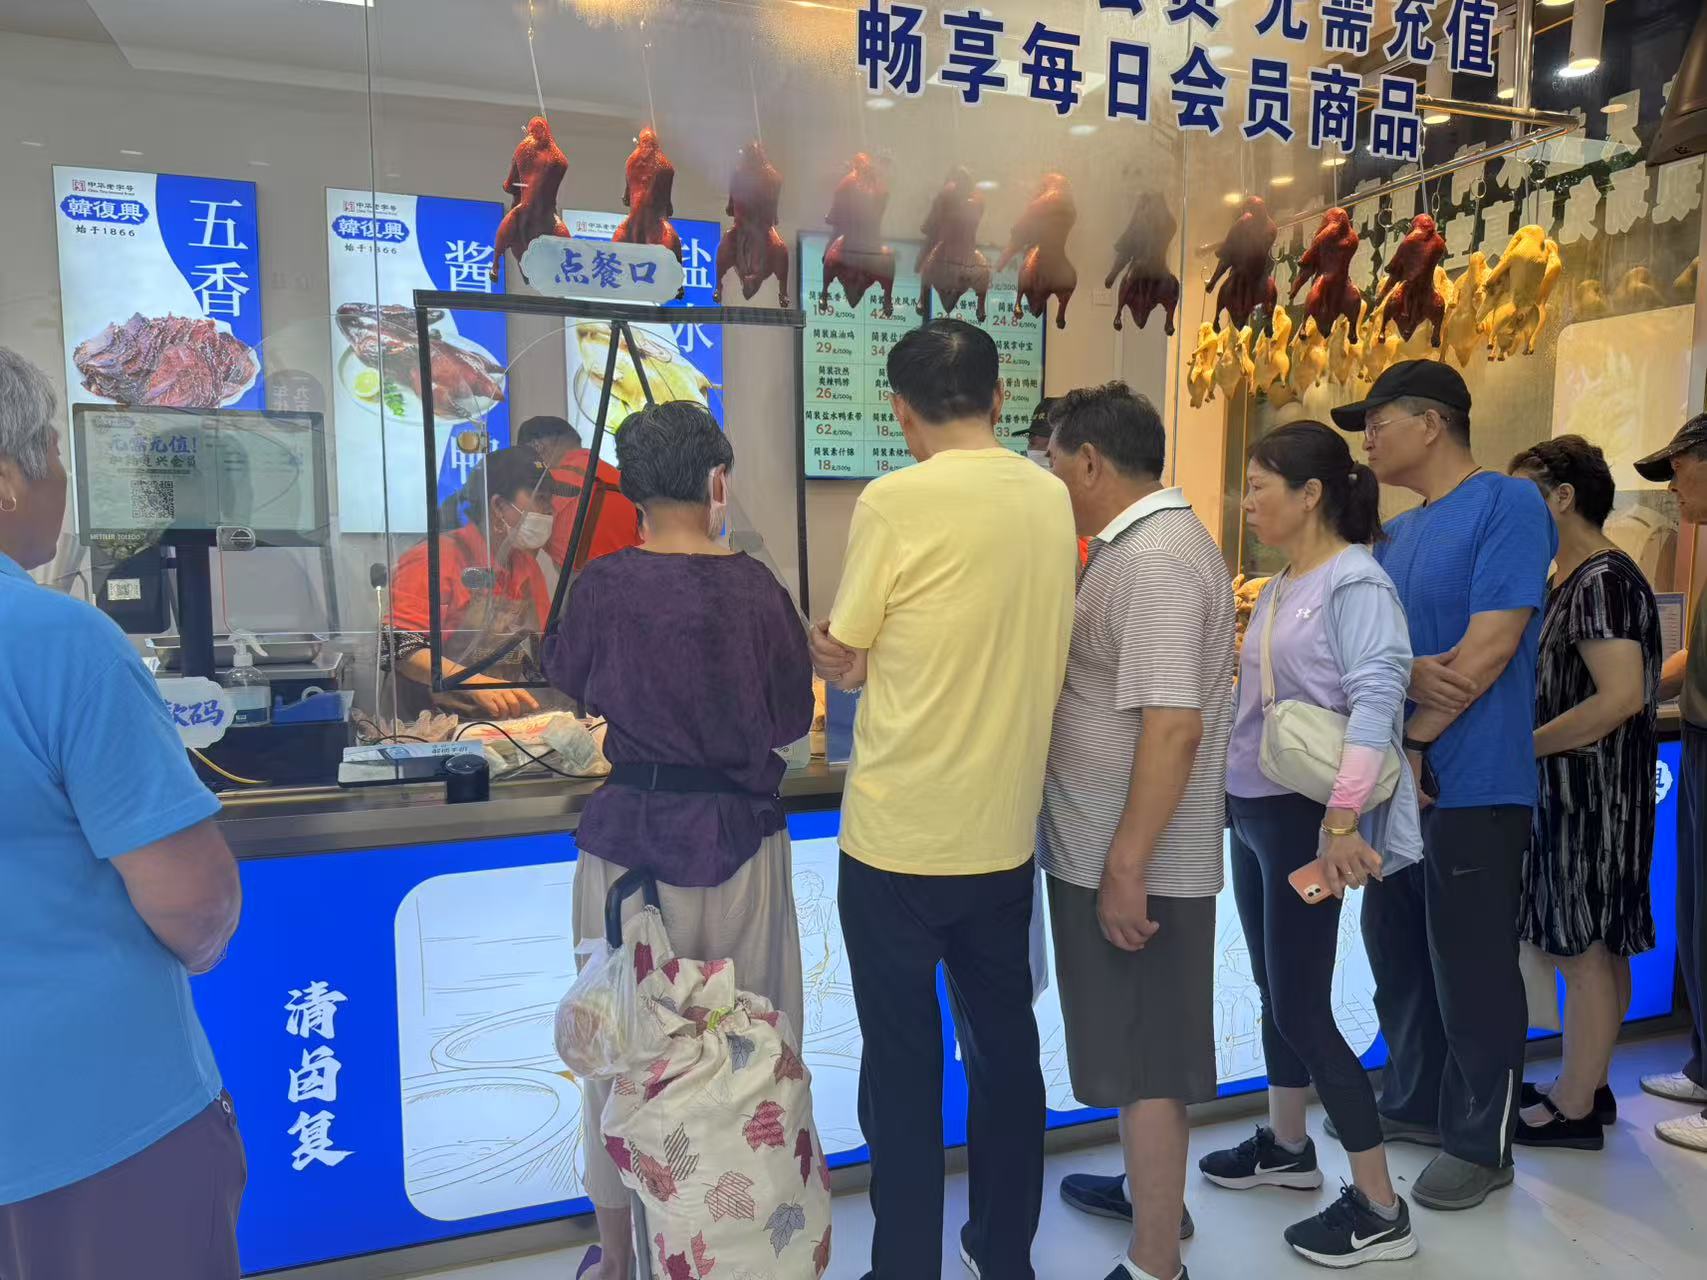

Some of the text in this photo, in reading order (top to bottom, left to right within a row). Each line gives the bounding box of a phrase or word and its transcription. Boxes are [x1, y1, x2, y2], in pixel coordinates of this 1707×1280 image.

[857, 0, 1420, 159] 畅享每日会员商品
[67, 198, 144, 222] 韓復興
[76, 225, 136, 237] 始于1866
[188, 200, 250, 317] 五香
[555, 248, 657, 289] 点餐口
[284, 980, 356, 1171] 清卤复
